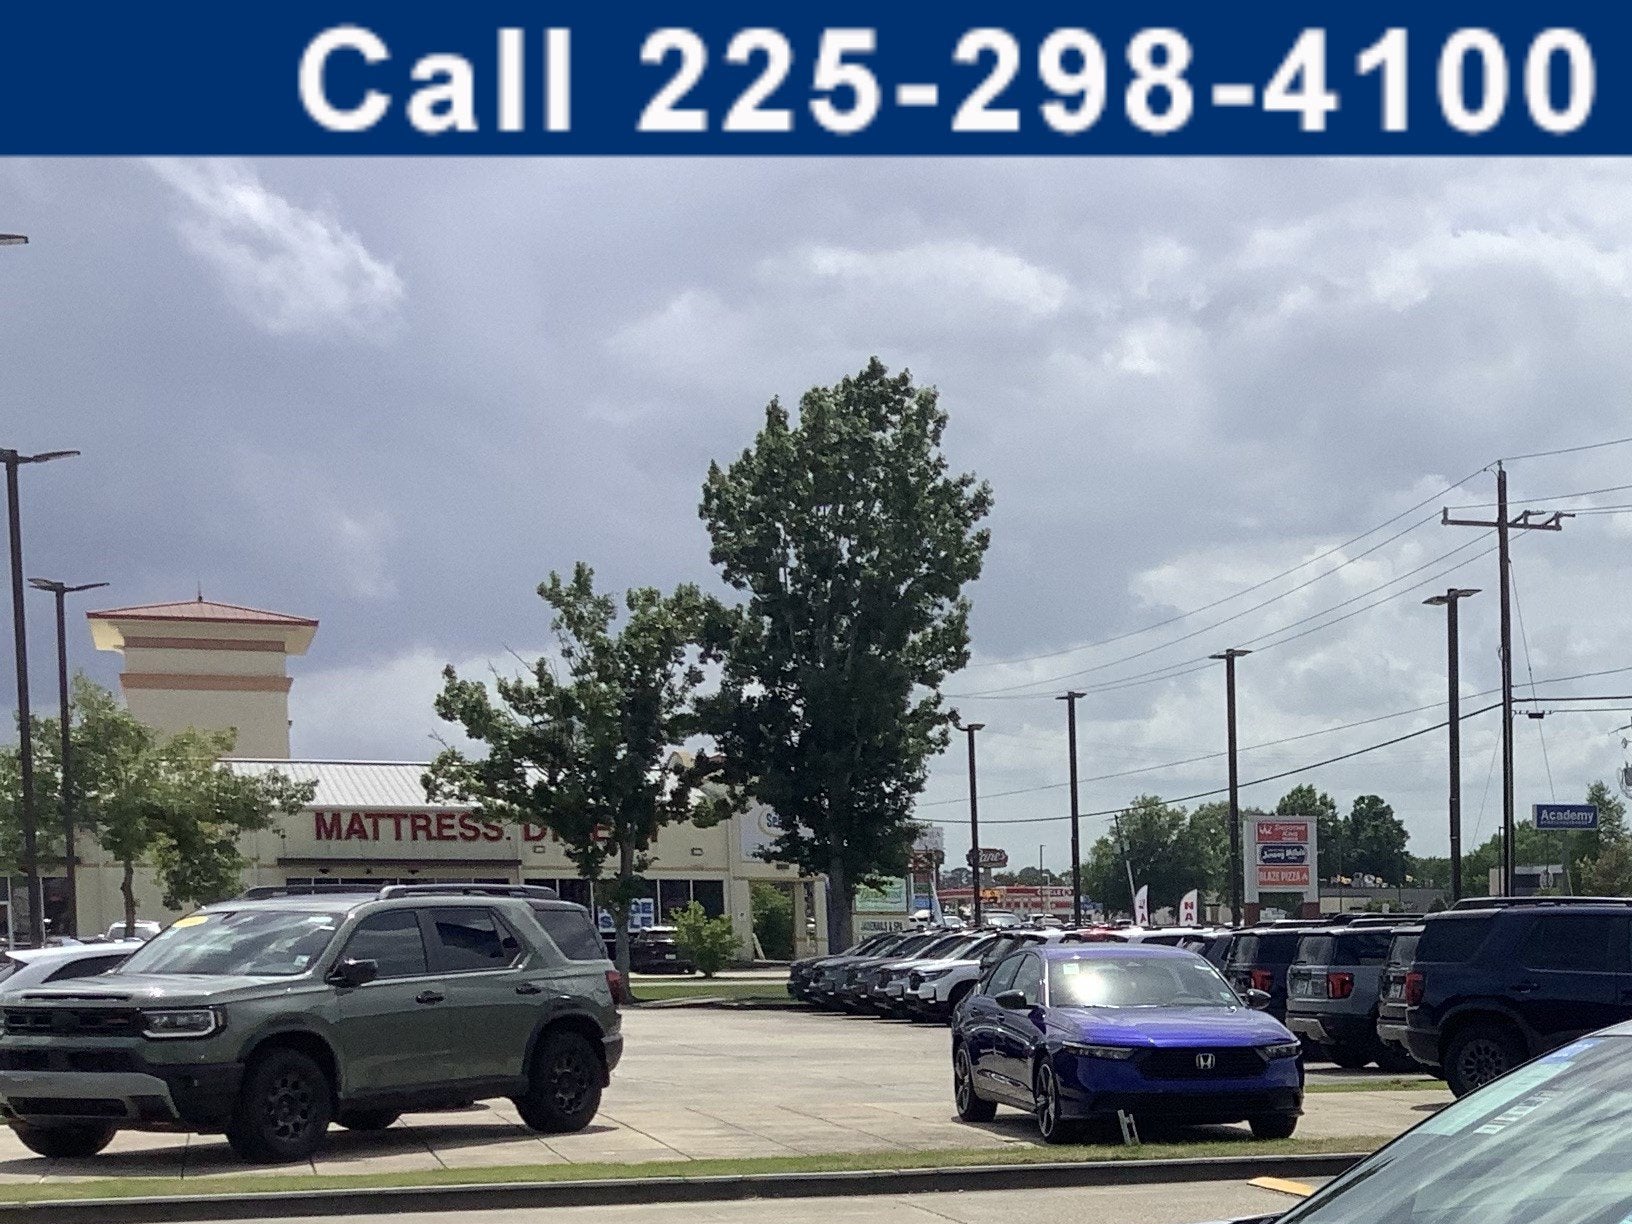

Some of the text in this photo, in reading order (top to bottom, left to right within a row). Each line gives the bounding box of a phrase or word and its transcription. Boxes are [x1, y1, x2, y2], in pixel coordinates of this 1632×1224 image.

[1541, 809, 1594, 824] Academy
[315, 812, 504, 841] MATTRESS
[600, 915, 652, 928] SLE
